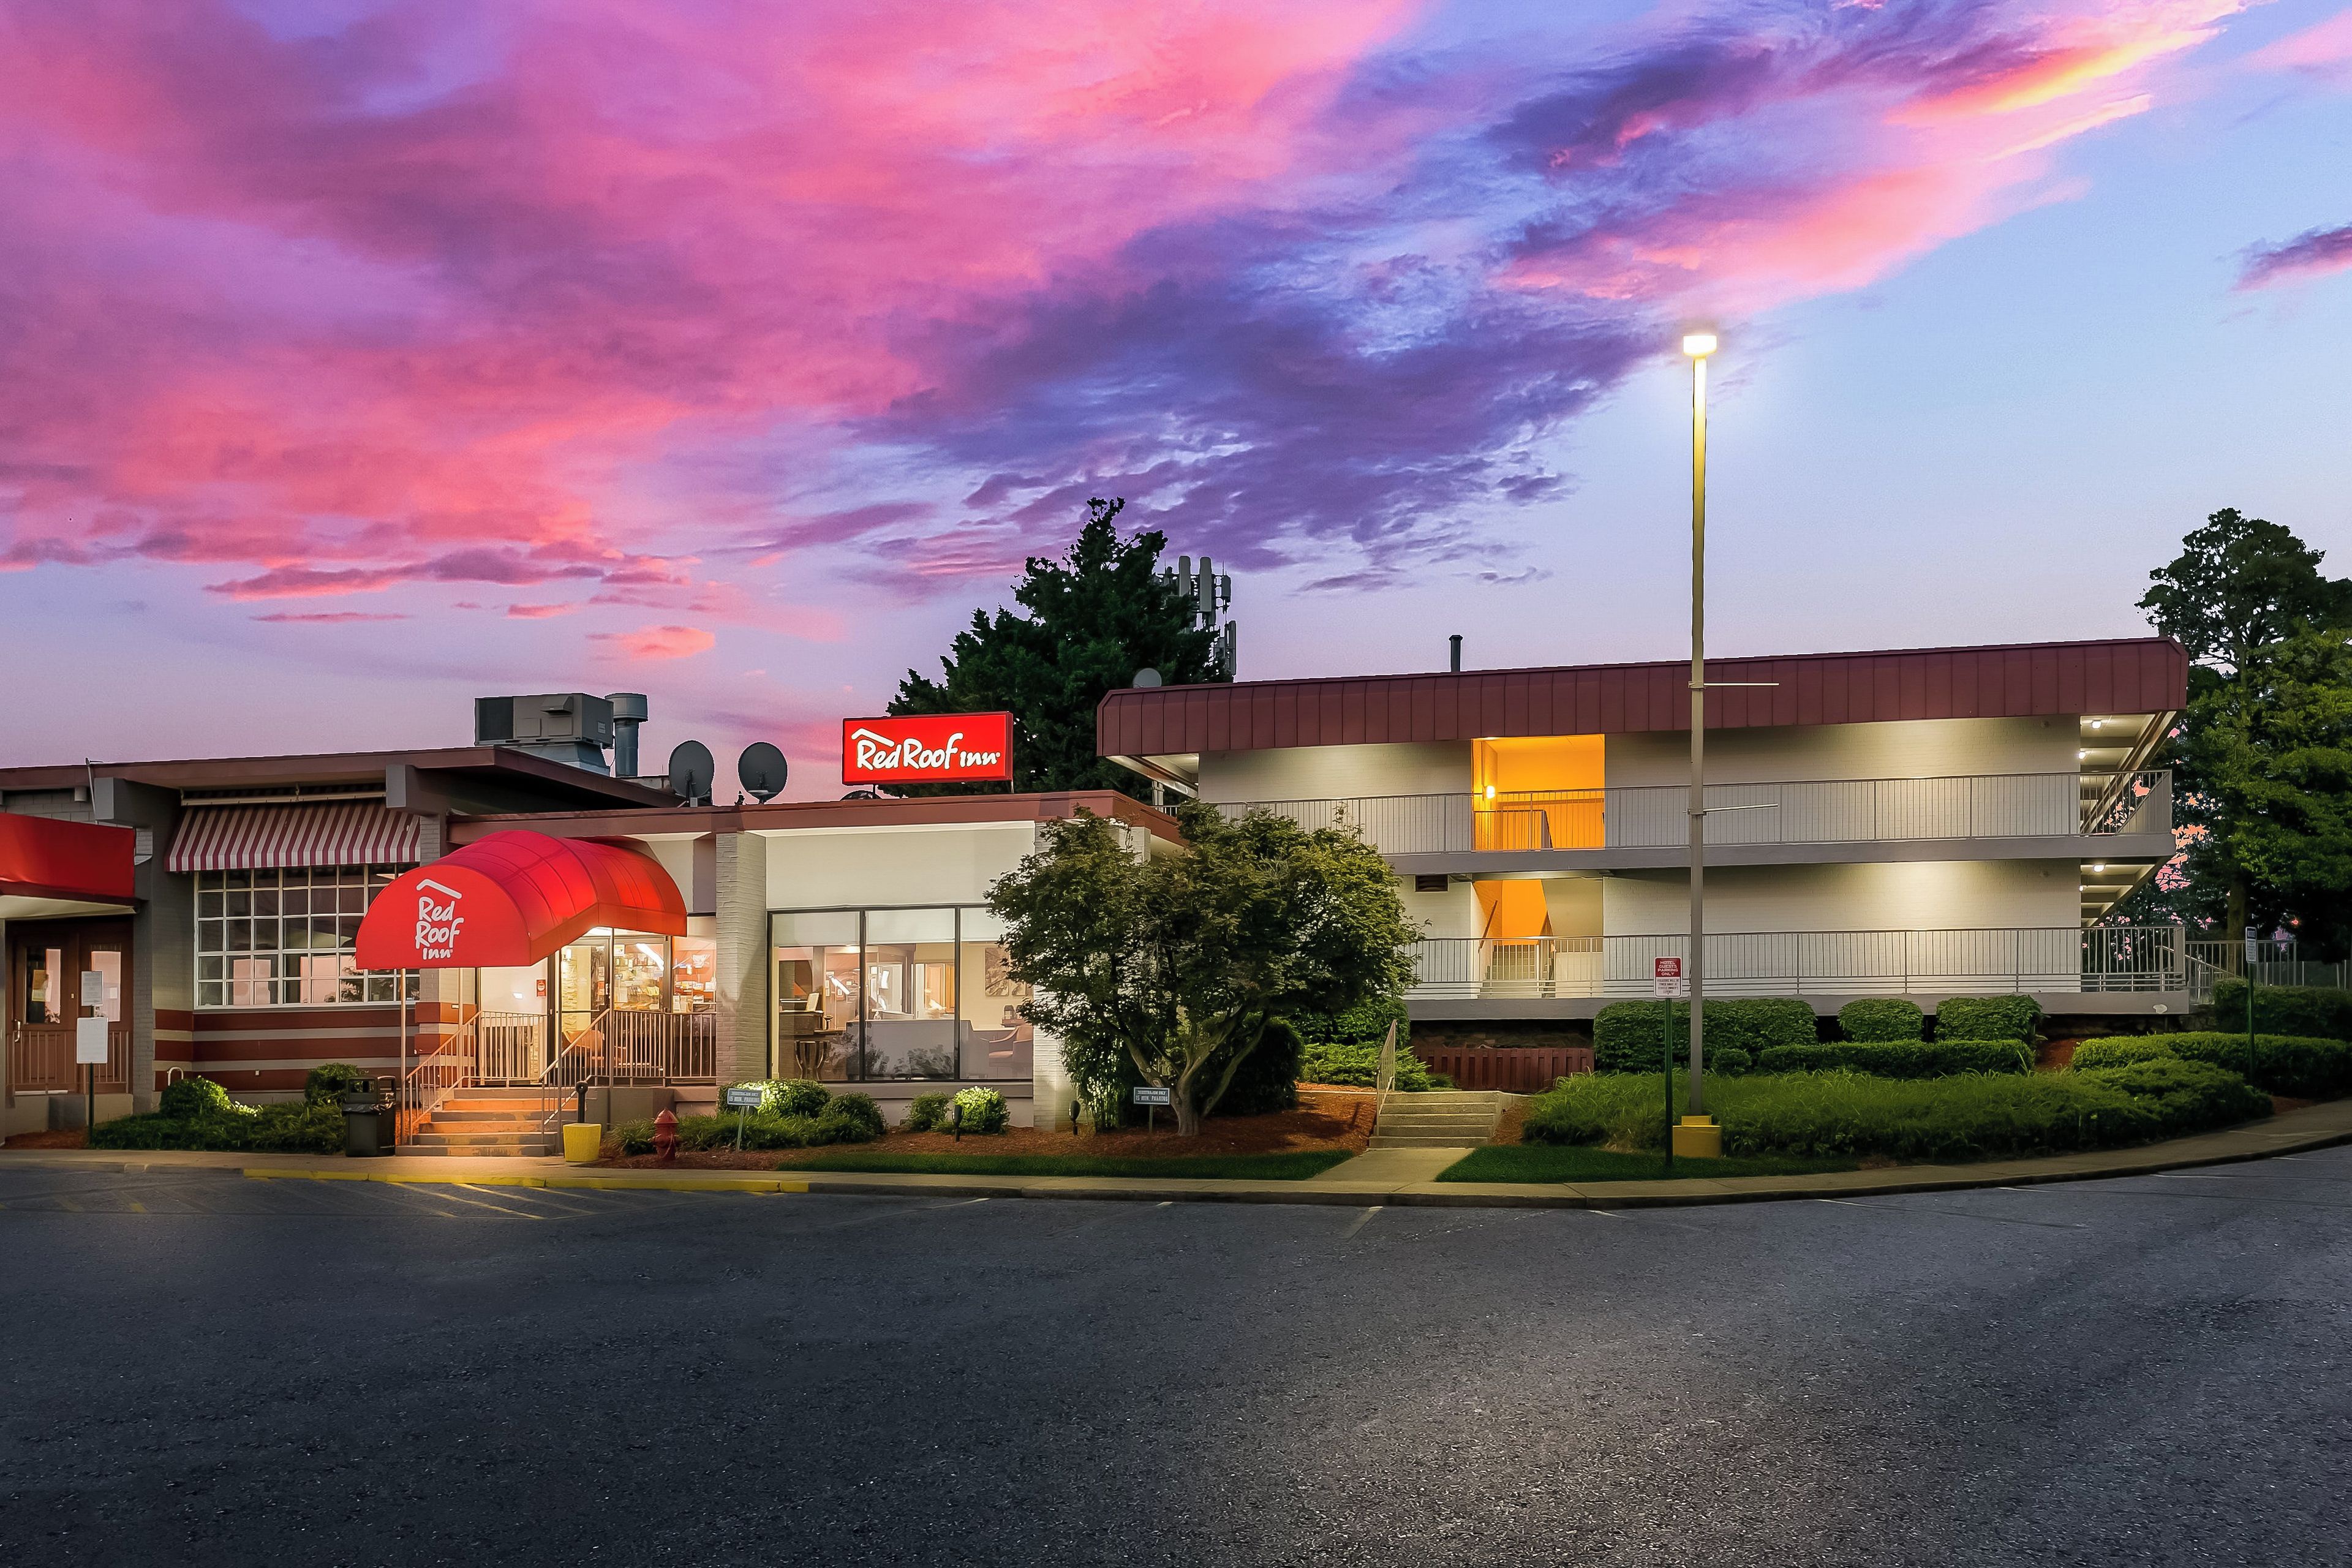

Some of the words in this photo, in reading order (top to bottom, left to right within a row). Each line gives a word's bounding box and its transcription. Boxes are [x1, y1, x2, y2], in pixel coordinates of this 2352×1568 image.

[858, 739, 902, 771] Red
[903, 733, 963, 769] Roof
[959, 751, 997, 768] Inn
[419, 896, 455, 922] Red
[415, 918, 464, 949] Roof
[423, 948, 451, 960] Inn
